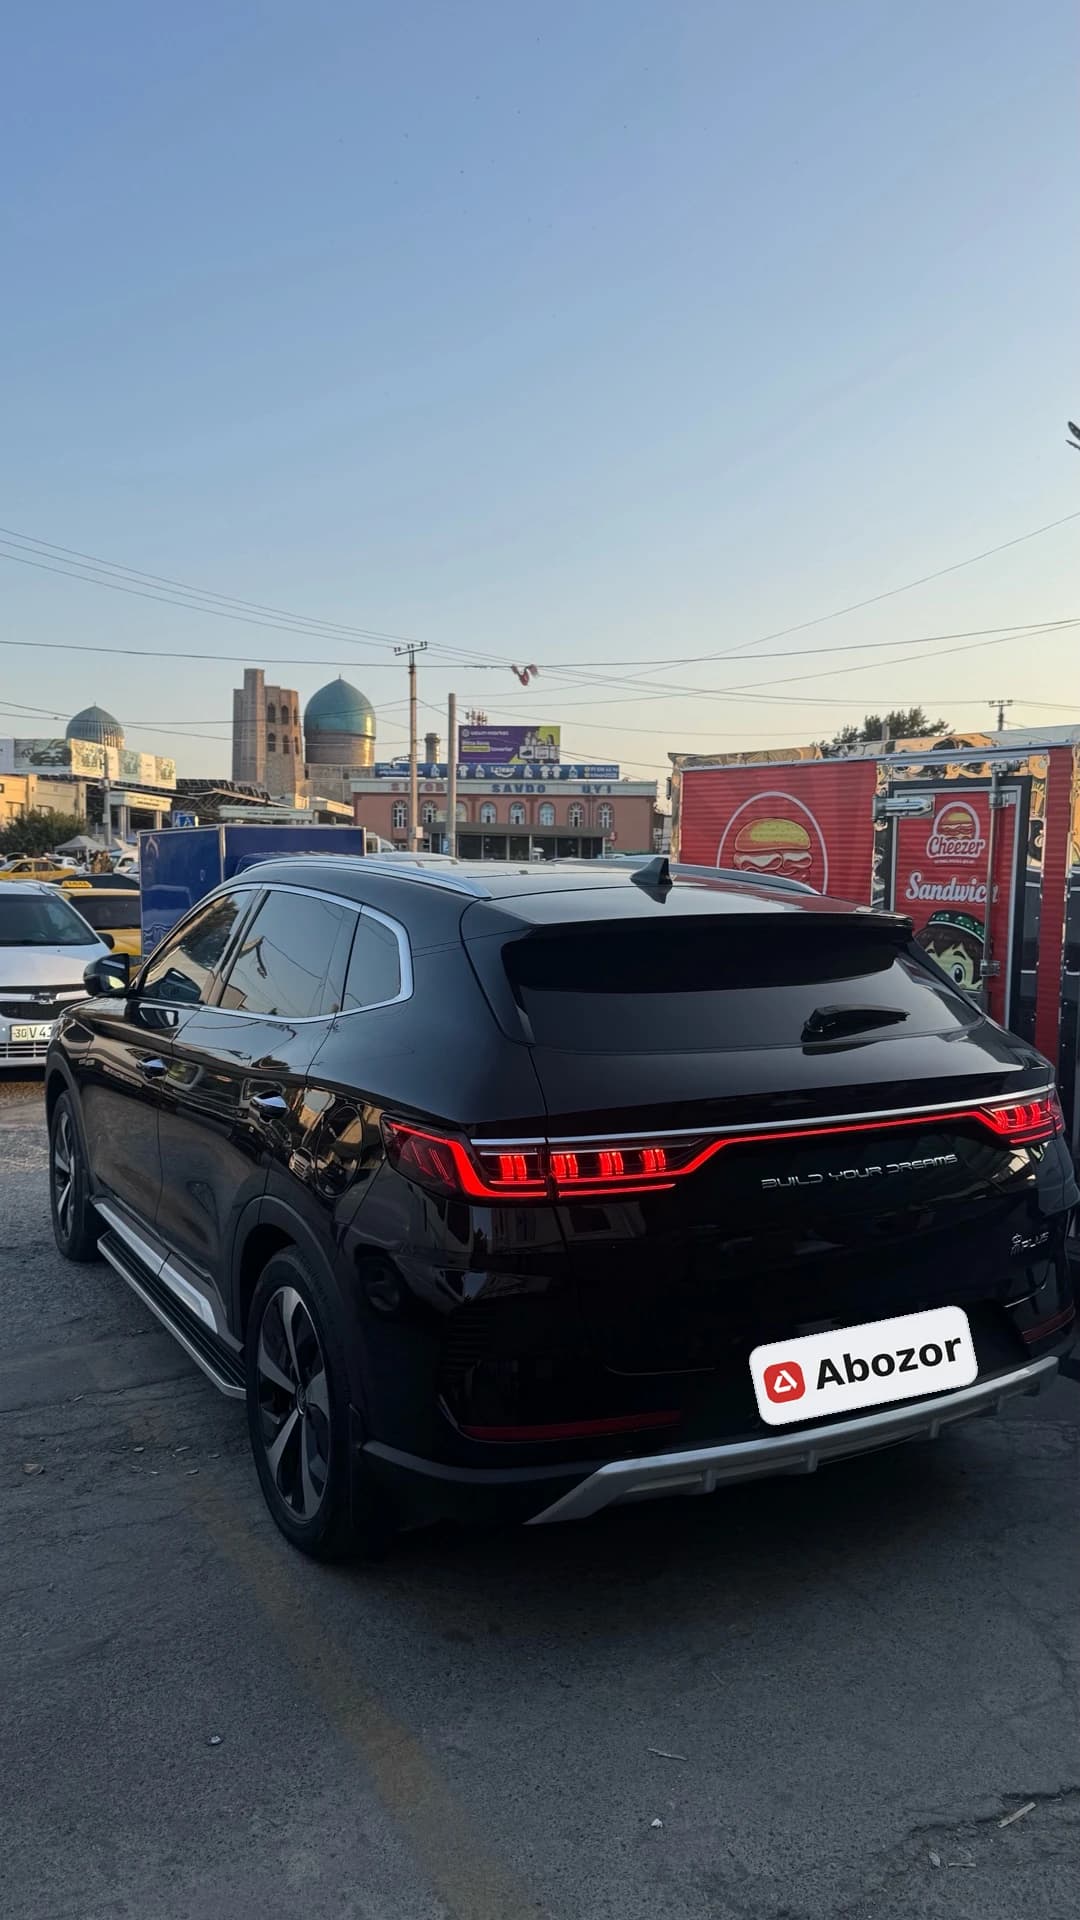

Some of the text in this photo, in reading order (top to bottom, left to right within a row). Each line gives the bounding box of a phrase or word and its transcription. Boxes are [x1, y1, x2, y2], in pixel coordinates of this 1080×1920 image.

[492, 783, 546, 794] SAVDO
[927, 835, 985, 857] Cheezer
[761, 1153, 959, 1189] BUILD YOUR DREAMS
